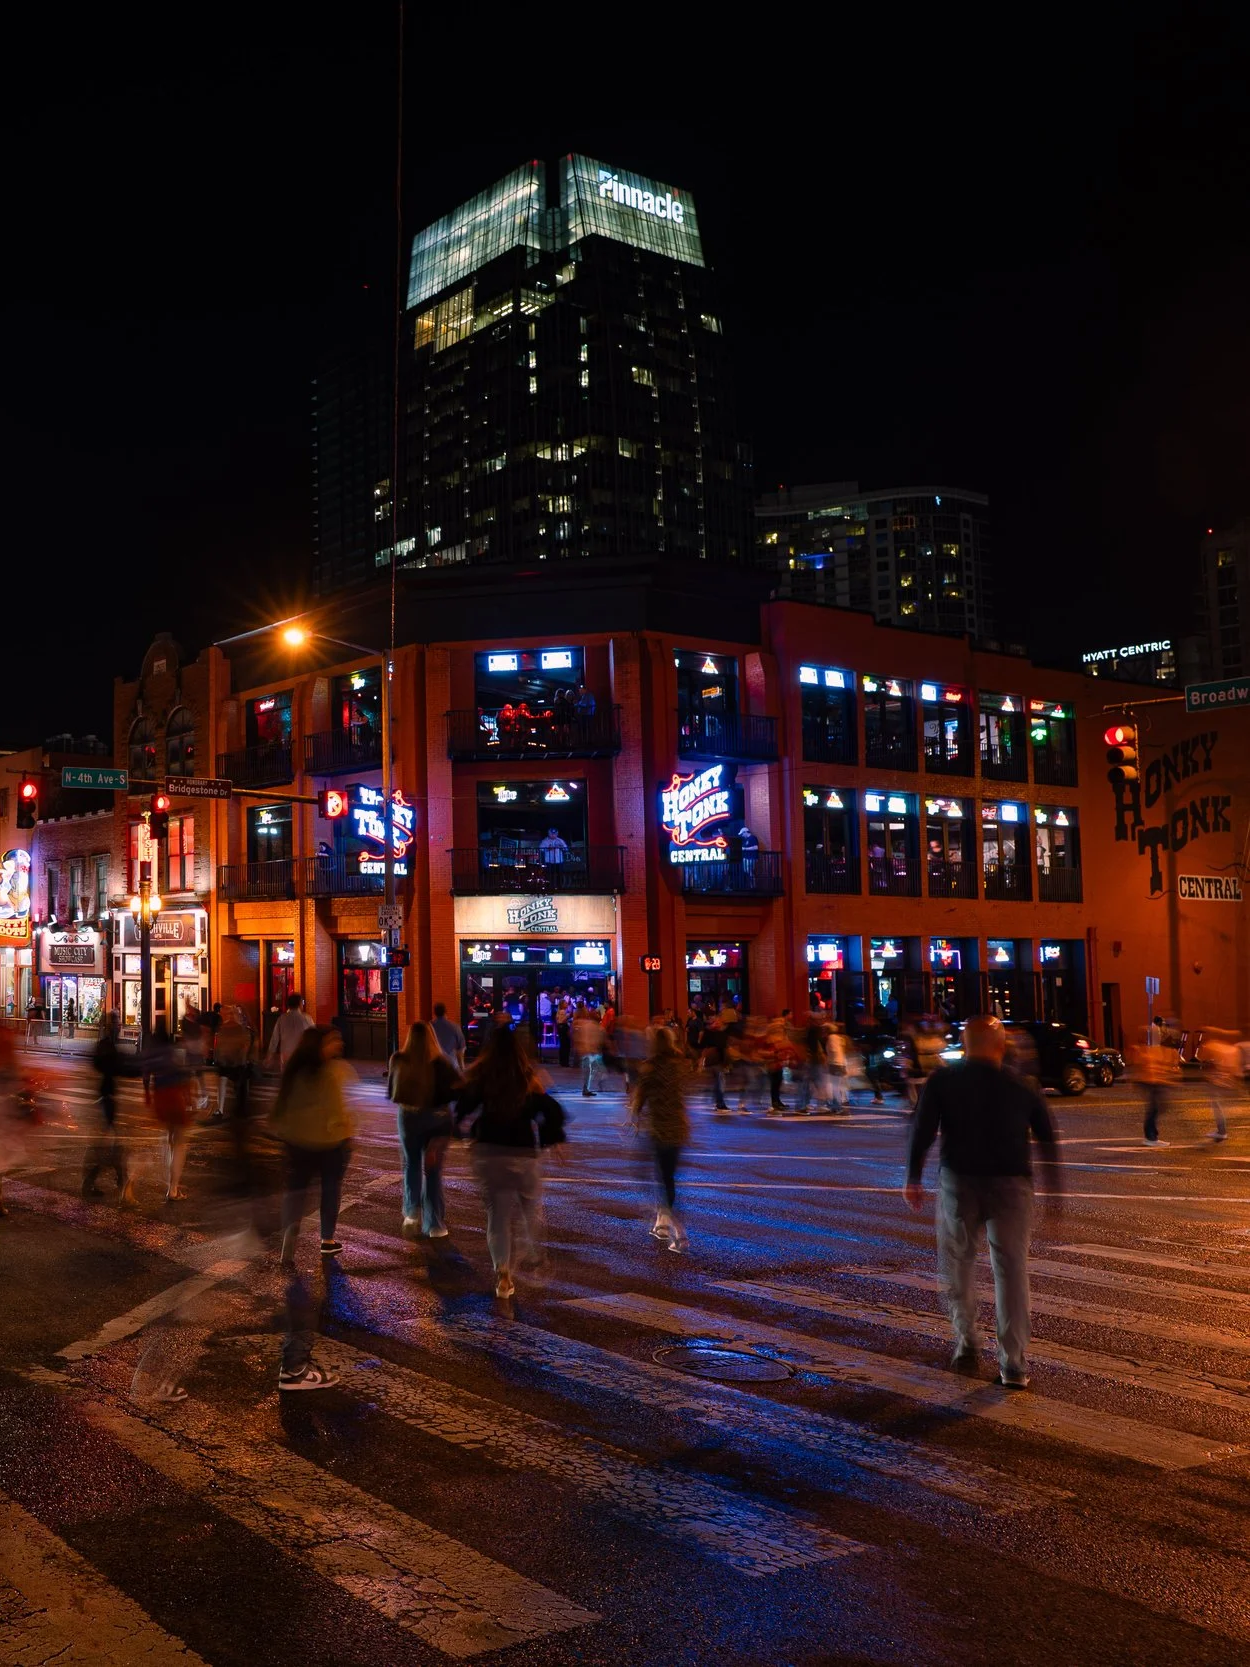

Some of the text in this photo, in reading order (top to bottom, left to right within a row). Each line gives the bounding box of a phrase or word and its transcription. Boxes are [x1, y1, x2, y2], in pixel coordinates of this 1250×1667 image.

[599, 169, 684, 224] Pinnacle
[1083, 640, 1171, 663] HYATT CENTRIC
[65, 773, 125, 785] N-4th Ave-S
[168, 784, 218, 796] Bridgestone
[1111, 731, 1218, 842] HONKY
[661, 764, 723, 823] HONKY
[673, 790, 729, 842] TONK
[670, 847, 726, 863] CENTRAL
[1137, 795, 1231, 895] TONK
[360, 862, 408, 875] CENTAL
[1179, 876, 1241, 899] CENTRAL
[378, 916, 389, 927] OK
[507, 898, 552, 924] HONKY
[518, 909, 557, 931] TONK
[54, 946, 88, 956] MUSIC CITY
